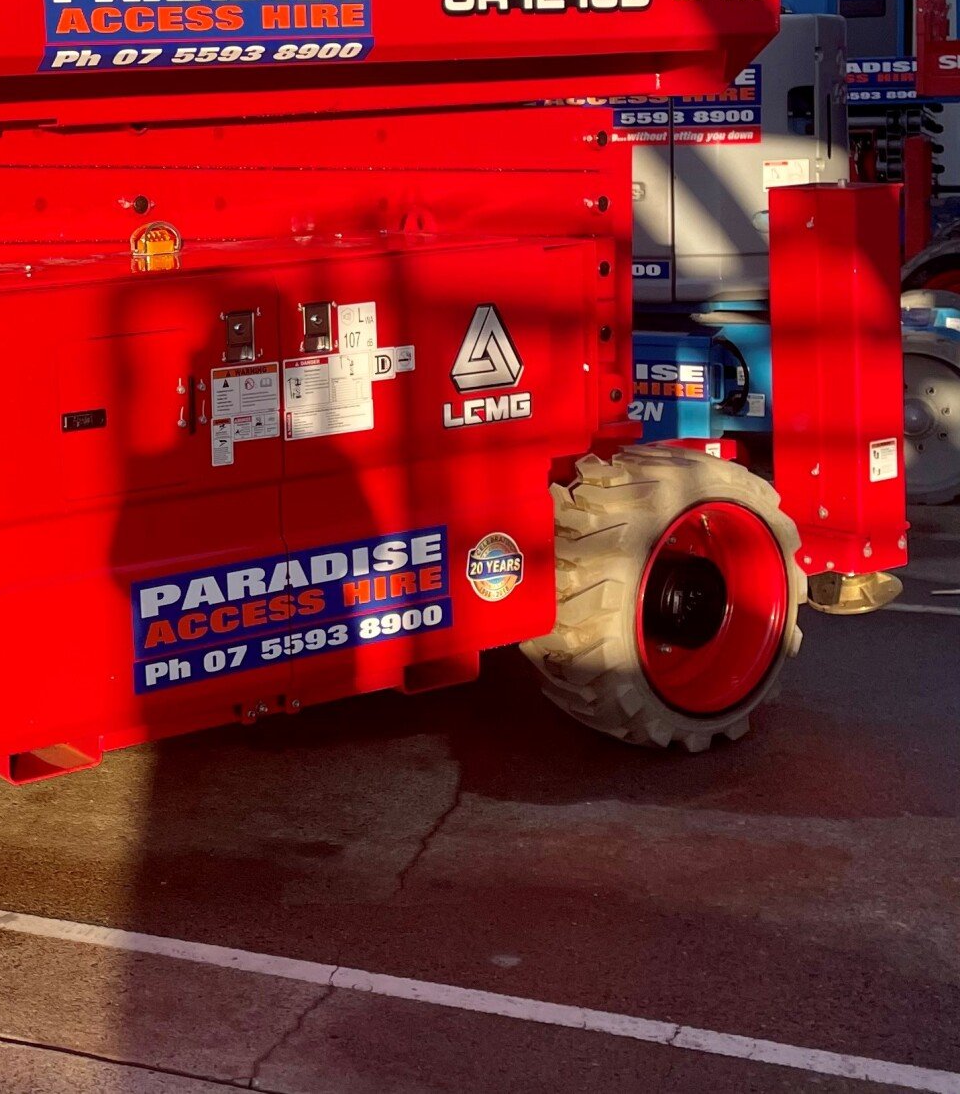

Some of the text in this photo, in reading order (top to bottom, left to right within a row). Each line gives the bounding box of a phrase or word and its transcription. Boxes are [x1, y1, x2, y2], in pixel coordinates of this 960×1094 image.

[56, 3, 365, 34] ACCESS HIRE
[51, 42, 363, 68] Ph 07 5593 8900
[938, 54, 960, 69] S
[693, 110, 754, 123] 8900
[705, 132, 726, 142] you
[727, 130, 754, 141] down
[344, 332, 361, 348] 107
[235, 366, 267, 375] WARNING
[443, 392, 532, 427] LGMG
[140, 533, 442, 618] PARADISE
[470, 558, 520, 575] 20 YEARS
[144, 566, 442, 648] ACCESS HIRE
[145, 605, 442, 686] Ph 07 5593 8900
